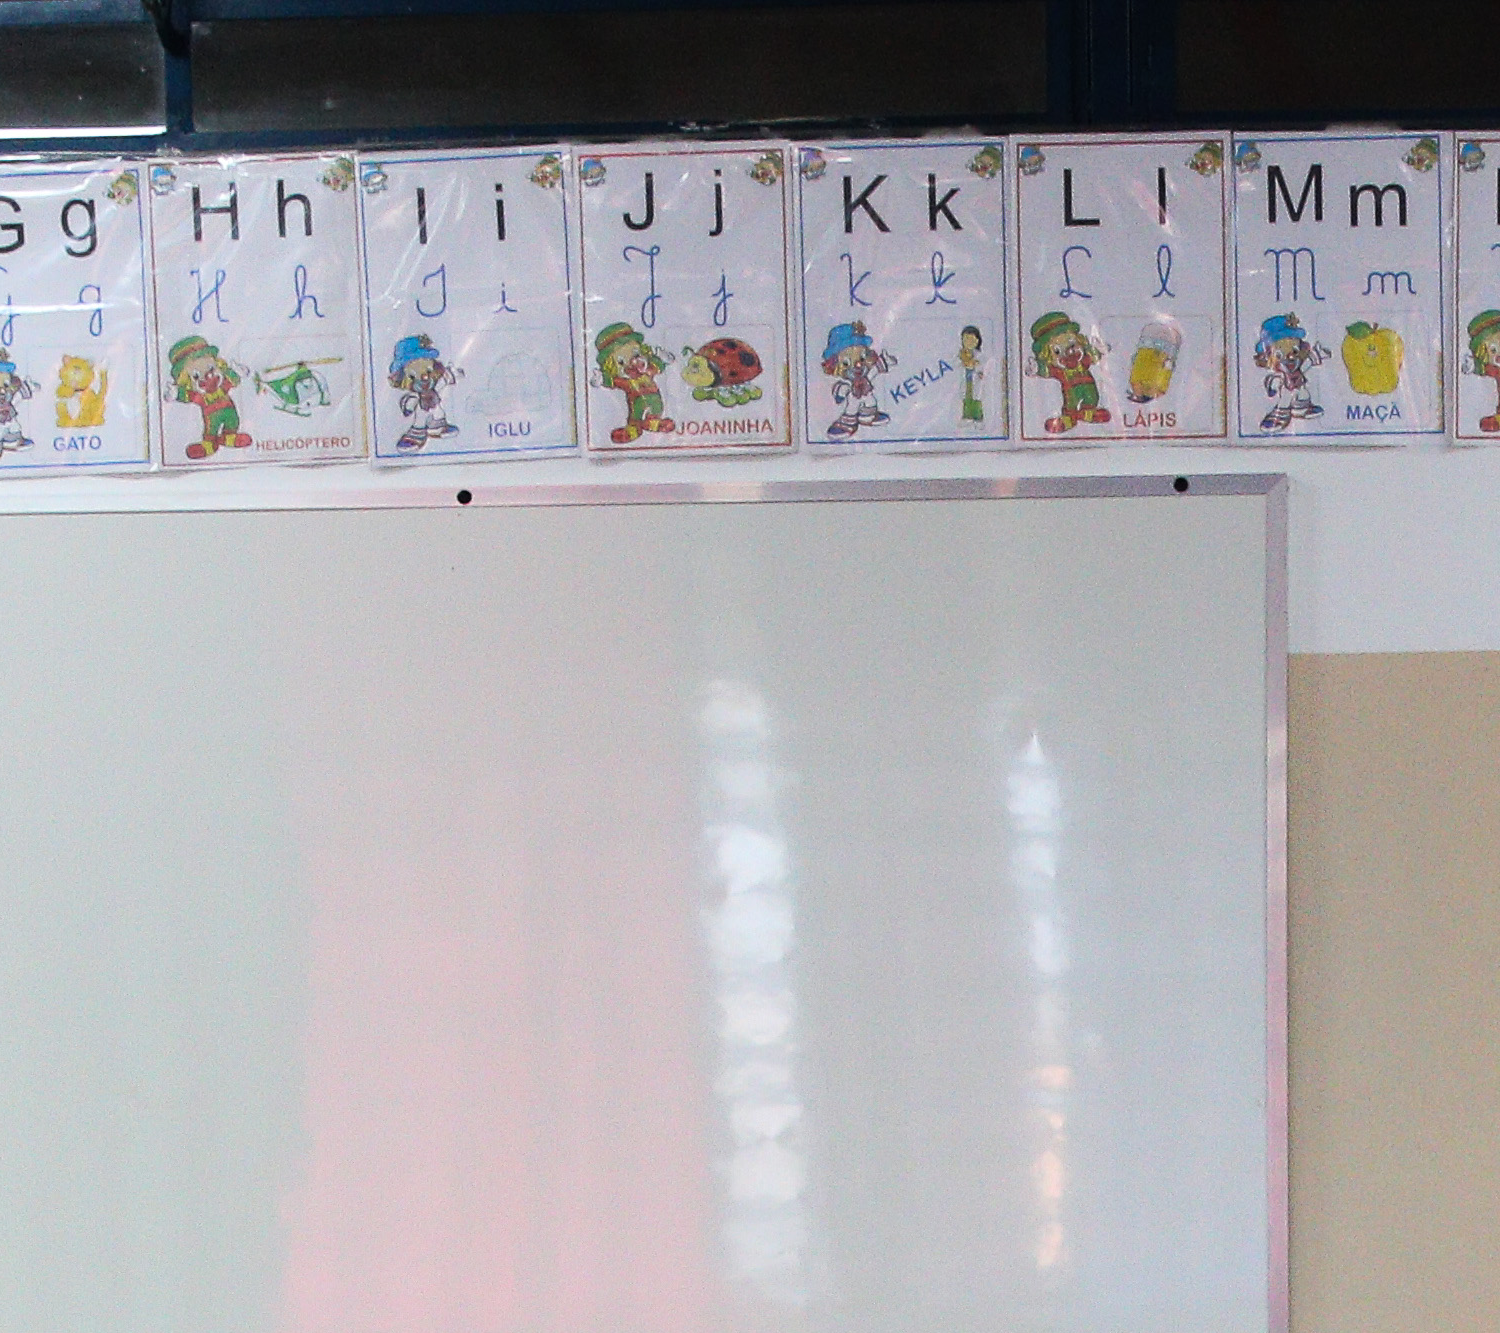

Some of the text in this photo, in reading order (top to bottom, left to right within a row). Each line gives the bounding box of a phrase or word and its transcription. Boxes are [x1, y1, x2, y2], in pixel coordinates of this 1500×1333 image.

[193, 180, 313, 241] H h
[417, 184, 506, 244] I i
[623, 170, 724, 236] J j
[843, 170, 962, 234] K k
[1064, 169, 1100, 227] L
[1267, 165, 1408, 226] M m
[61, 198, 99, 257] g
[889, 358, 953, 404] KEYLA
[488, 422, 531, 437] IGLU
[677, 419, 774, 435] JOANINHA
[1123, 409, 1177, 428] LÁPIS
[1346, 401, 1401, 422] MAÇÃ
[53, 435, 101, 451] GATO
